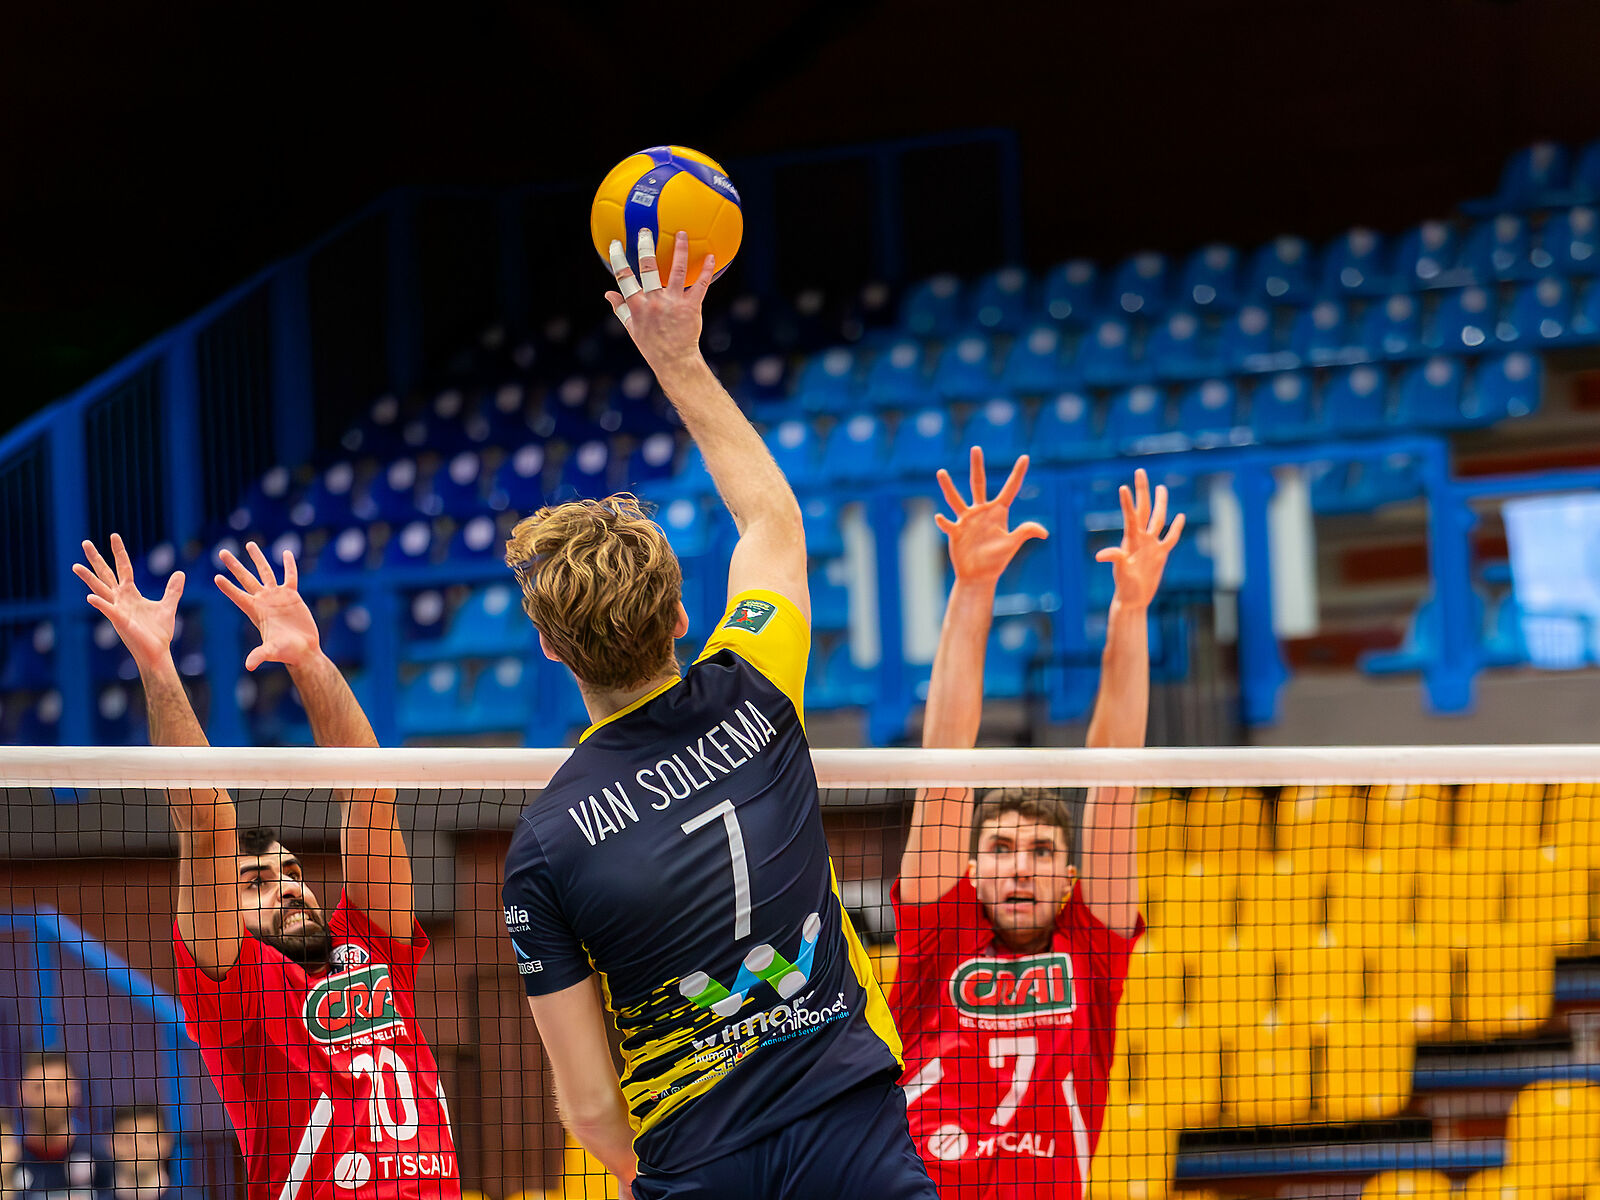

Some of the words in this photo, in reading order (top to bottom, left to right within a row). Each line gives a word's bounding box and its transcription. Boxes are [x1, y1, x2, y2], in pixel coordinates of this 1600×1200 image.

[568, 781, 640, 847] VAN
[635, 700, 778, 811] SOLKEMA
[681, 799, 752, 941] 7
[315, 975, 396, 1030] CRA
[960, 965, 1066, 1007] CRAI
[348, 1046, 419, 1142] 10
[988, 1036, 1039, 1127] 7
[379, 1154, 453, 1179] TISCALI
